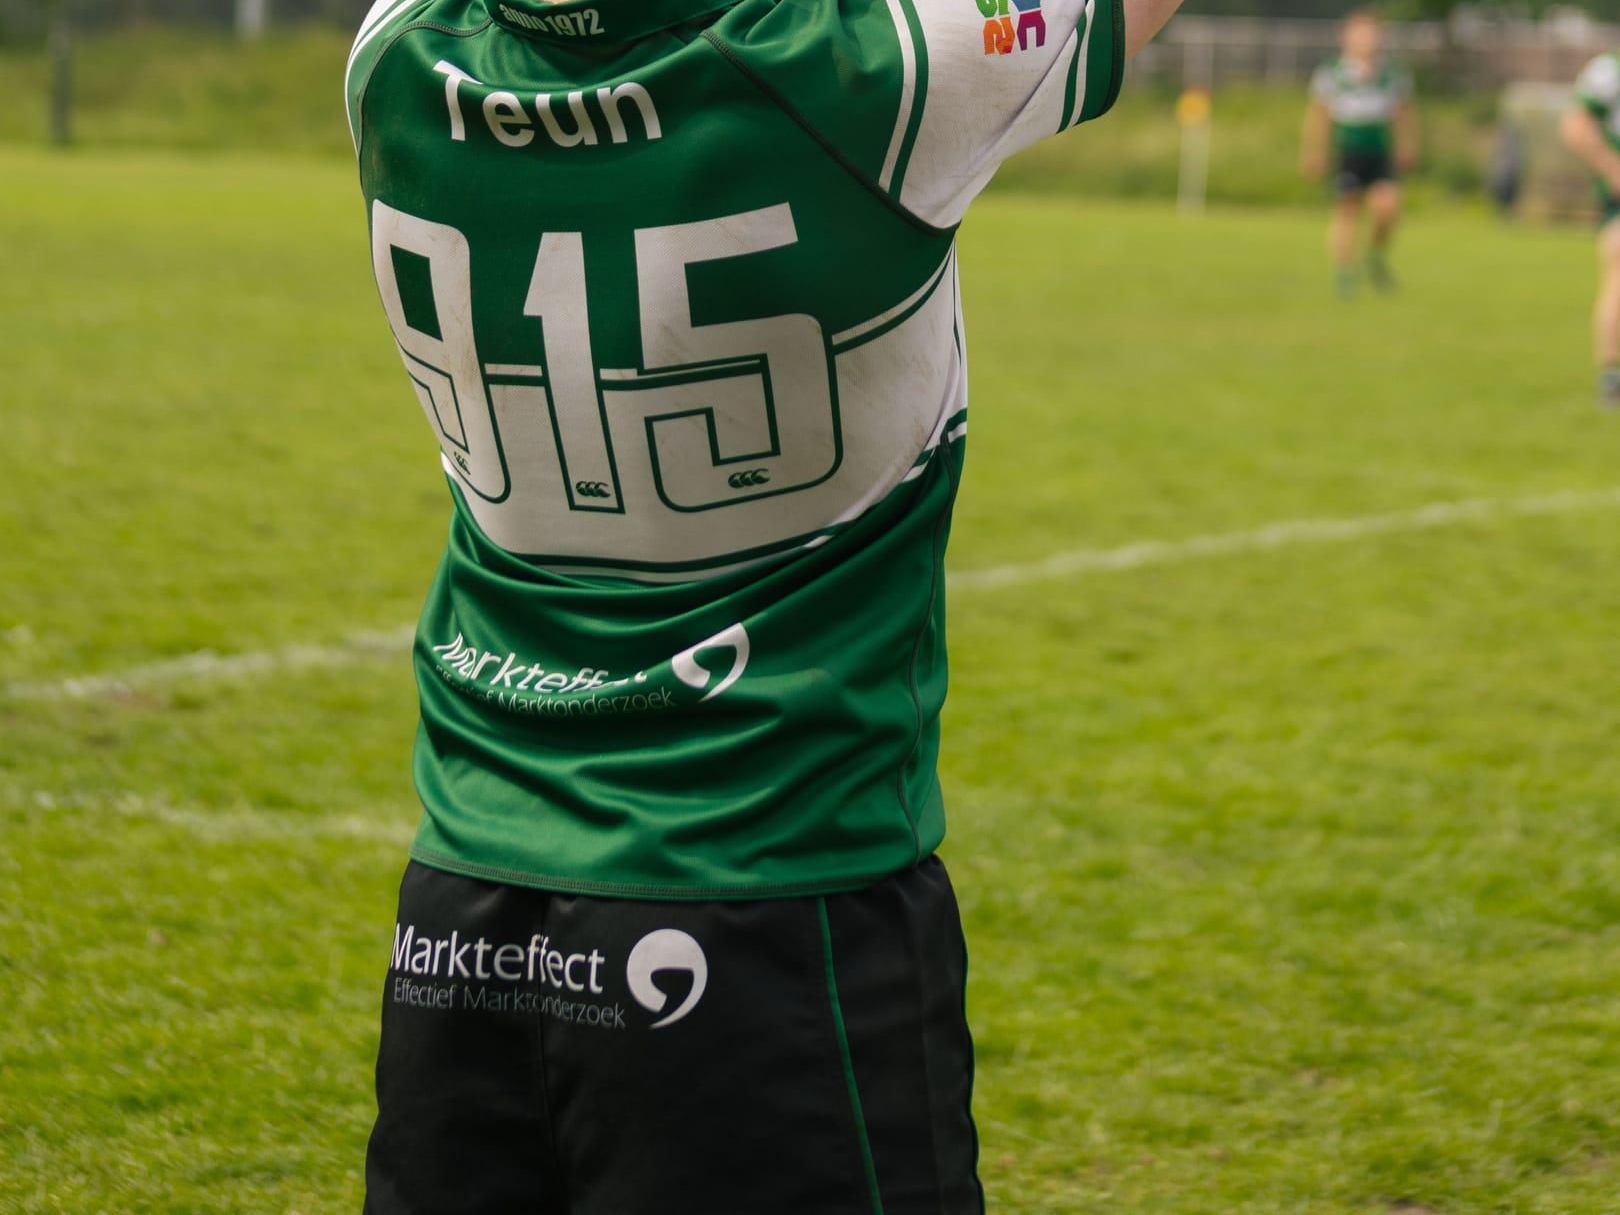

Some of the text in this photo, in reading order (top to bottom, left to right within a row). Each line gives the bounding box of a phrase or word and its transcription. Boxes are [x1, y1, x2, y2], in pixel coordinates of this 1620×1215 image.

[499, 4, 605, 36] anno 1972
[433, 59, 662, 147] Teun
[390, 922, 605, 994] Markteffect
[393, 977, 626, 1028] Effectief Marktonderzoek
